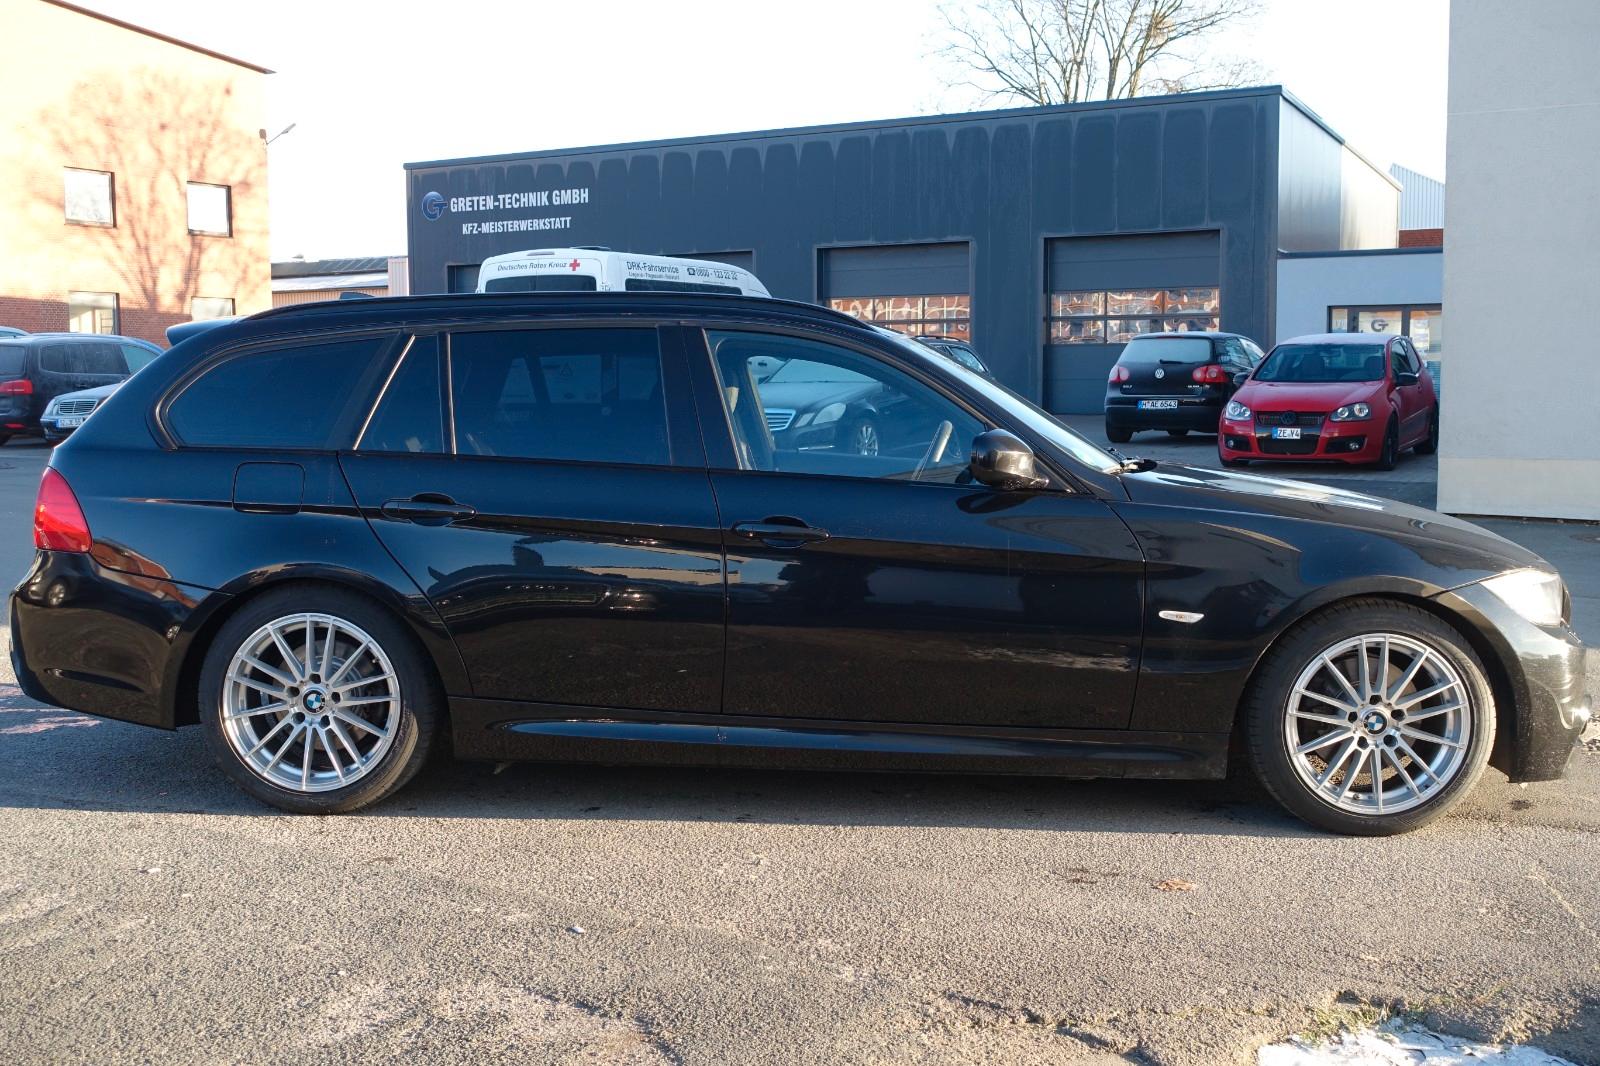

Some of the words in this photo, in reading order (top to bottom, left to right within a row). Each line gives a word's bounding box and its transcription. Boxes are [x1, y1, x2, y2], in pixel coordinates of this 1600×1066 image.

[450, 191, 549, 212] GRETEN-TECHNIK
[552, 188, 589, 205] GMBH
[462, 217, 572, 235] KFZ-MEISTERWERKSTATT
[497, 263, 528, 271] Deutsches
[626, 261, 679, 274] DRK-Fahrservice
[1150, 400, 1158, 408] AE
[1159, 400, 1177, 408] 6543
[1278, 429, 1287, 437] ZE
